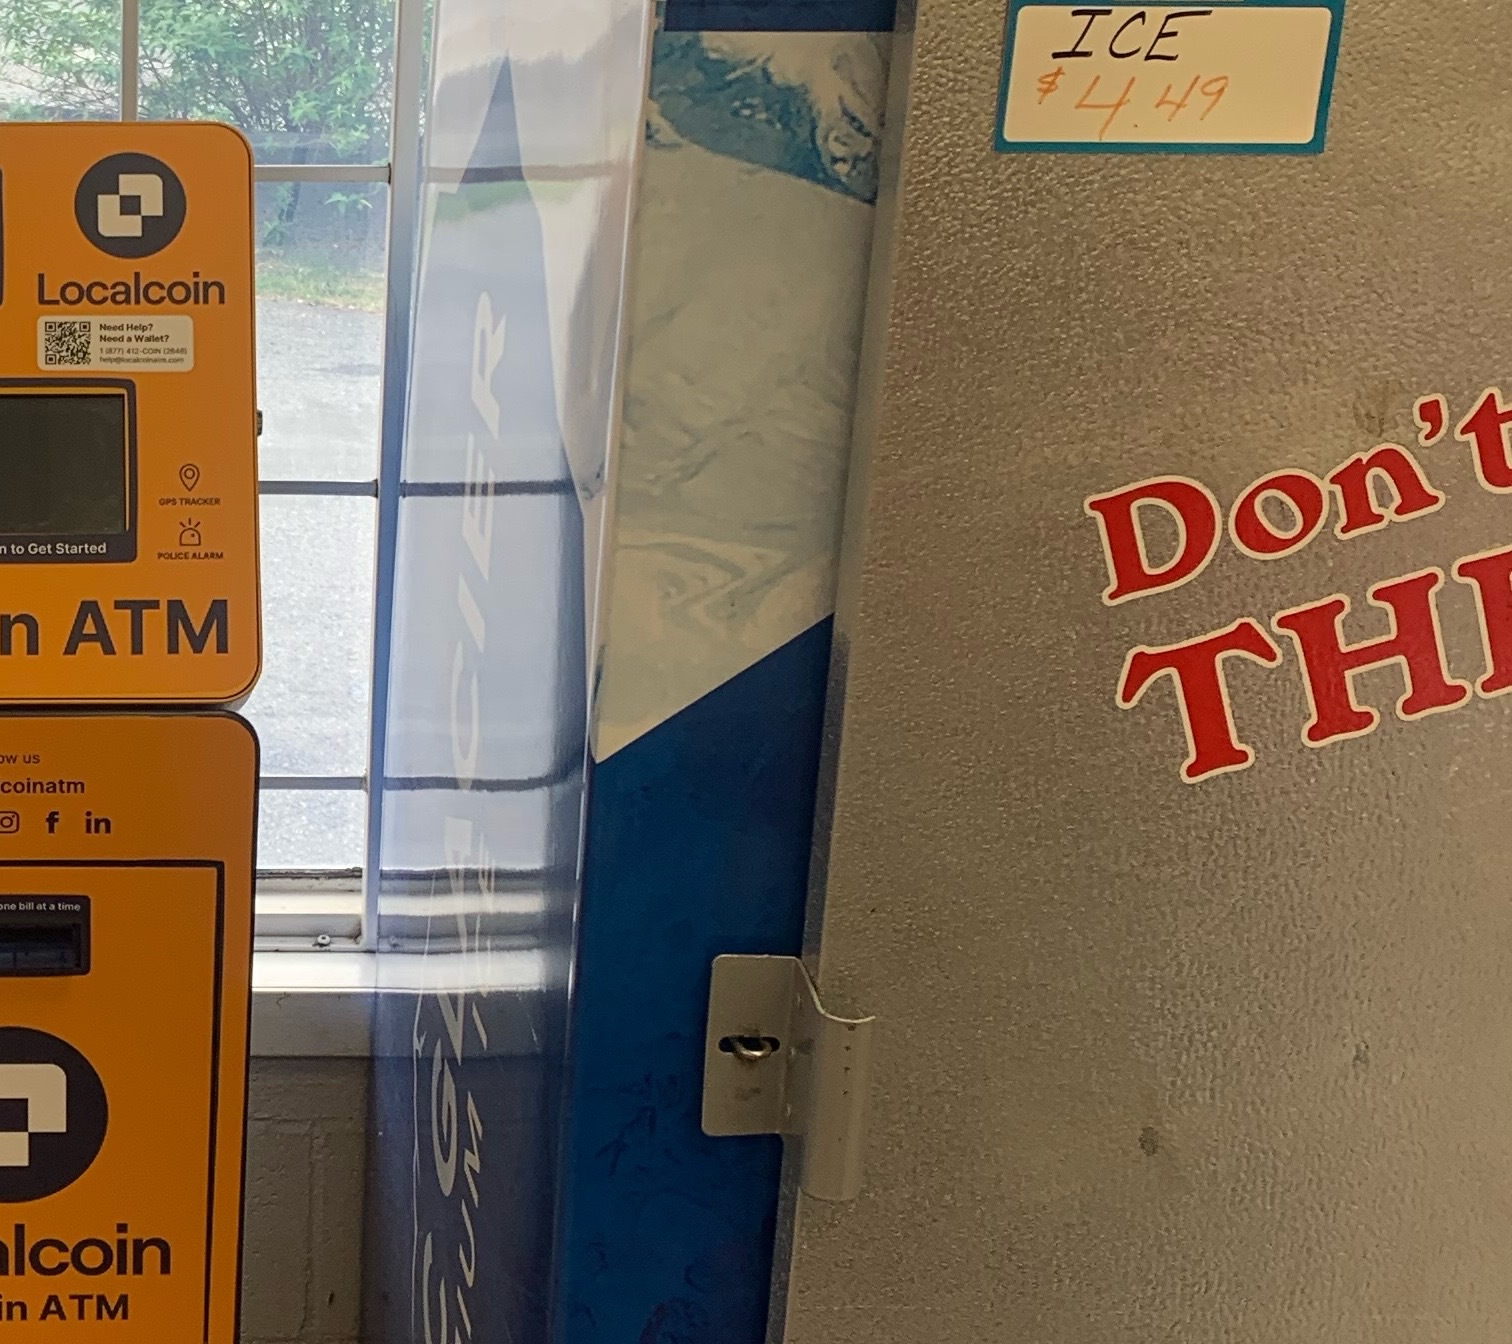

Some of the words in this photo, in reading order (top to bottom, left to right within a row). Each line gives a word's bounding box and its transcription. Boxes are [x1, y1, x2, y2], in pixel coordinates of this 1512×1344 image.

[1051, 8, 1214, 62] ICE
[37, 270, 226, 306] Localcoin
[99, 323, 124, 332] Need
[126, 323, 154, 333] Help?
[99, 334, 124, 343] Need
[134, 334, 170, 343] Wallet?
[159, 496, 177, 506] GPS
[179, 496, 221, 506] TRACKER
[1083, 387, 1512, 606] Don't
[10, 542, 26, 555] to
[28, 541, 53, 556] Get
[55, 541, 107, 555] Started
[157, 551, 189, 560] POLICE
[191, 551, 224, 560] ALARM
[63, 598, 229, 657] ATM
[22, 753, 41, 765] us
[18, 902, 34, 911] bill
[36, 902, 46, 911] at
[57, 902, 81, 911] time
[39, 1293, 130, 1322] ATM
